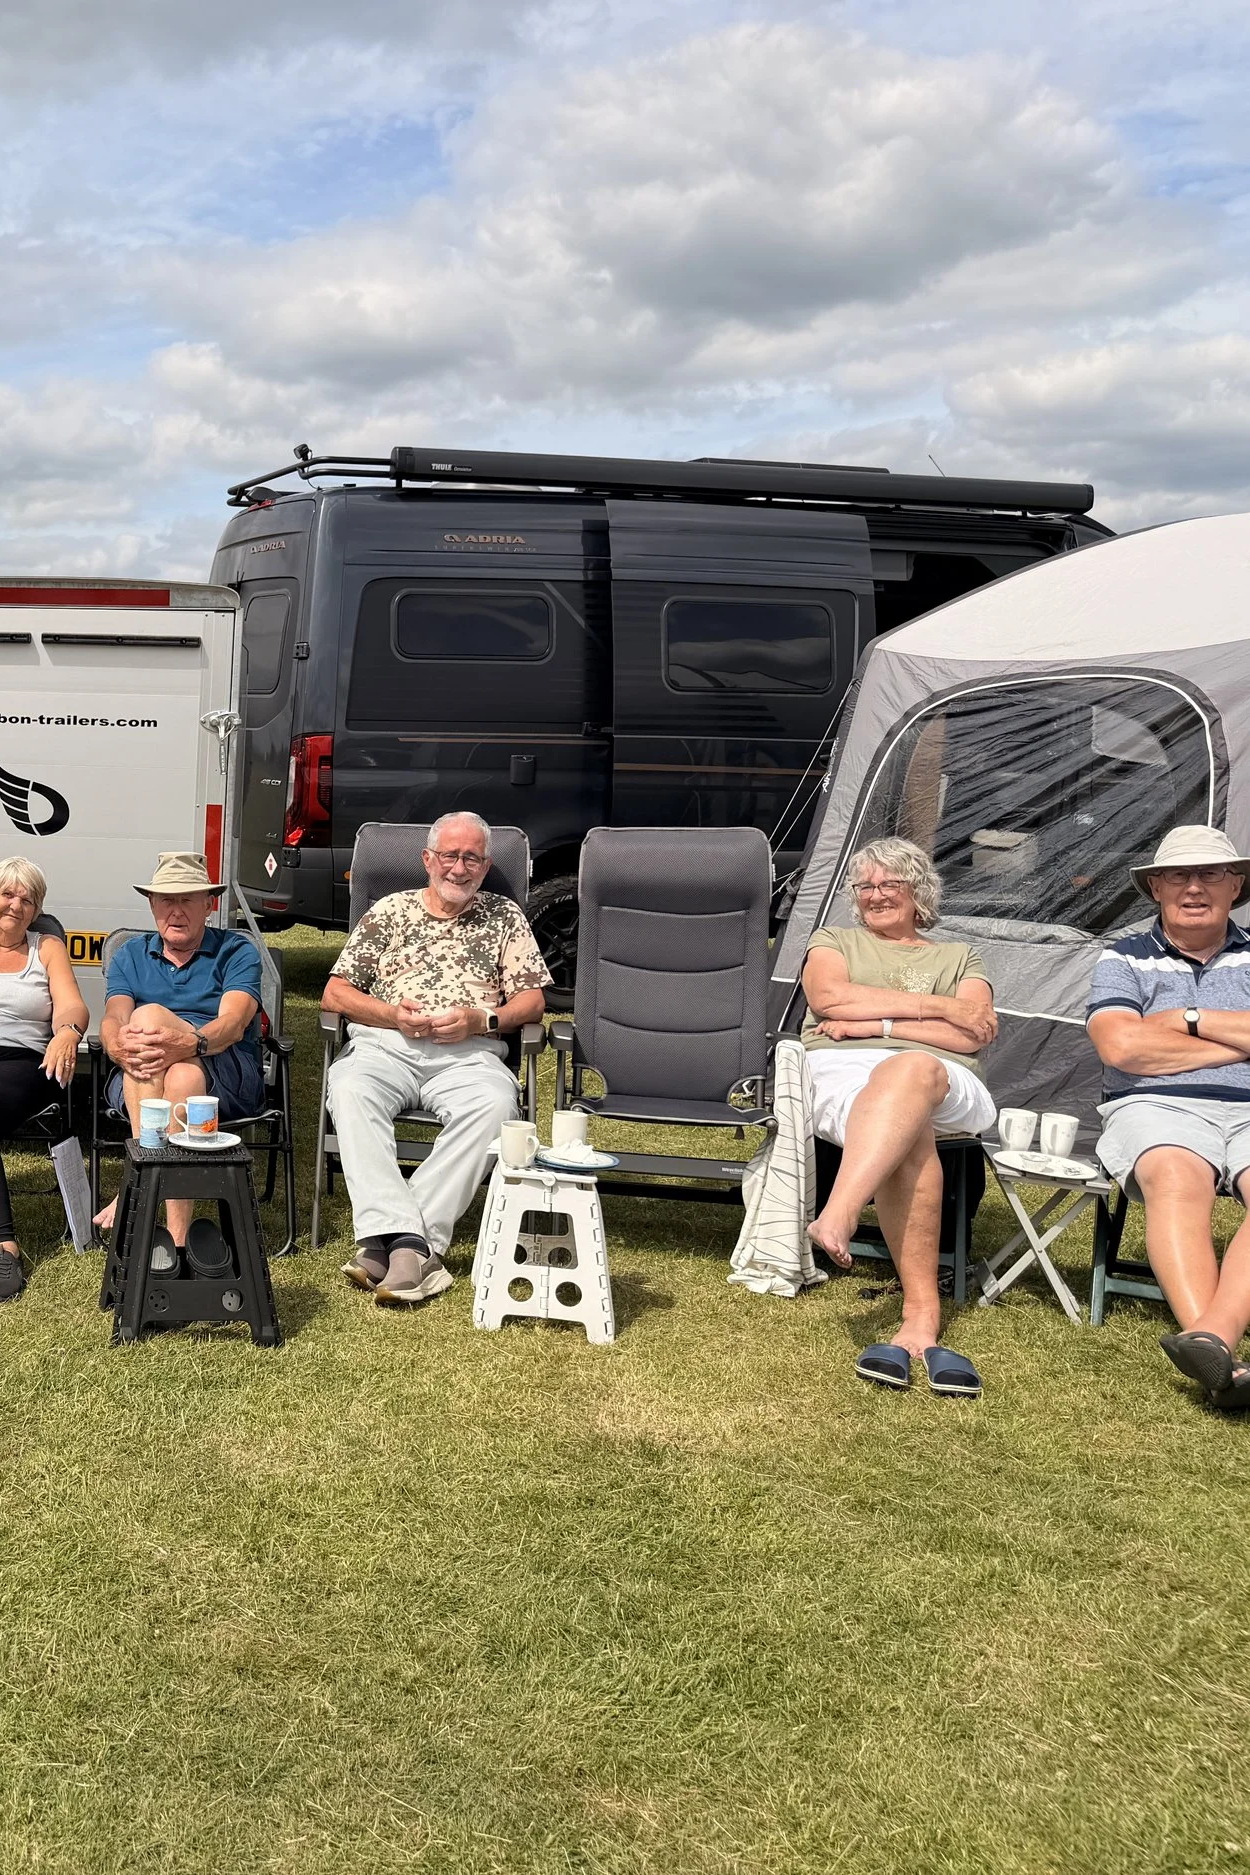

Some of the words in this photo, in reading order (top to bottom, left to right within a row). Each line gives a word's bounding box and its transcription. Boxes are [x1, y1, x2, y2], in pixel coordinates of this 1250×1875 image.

[431, 463, 453, 472] THULE
[464, 534, 527, 544] ADRIA
[65, 934, 105, 961] OW
